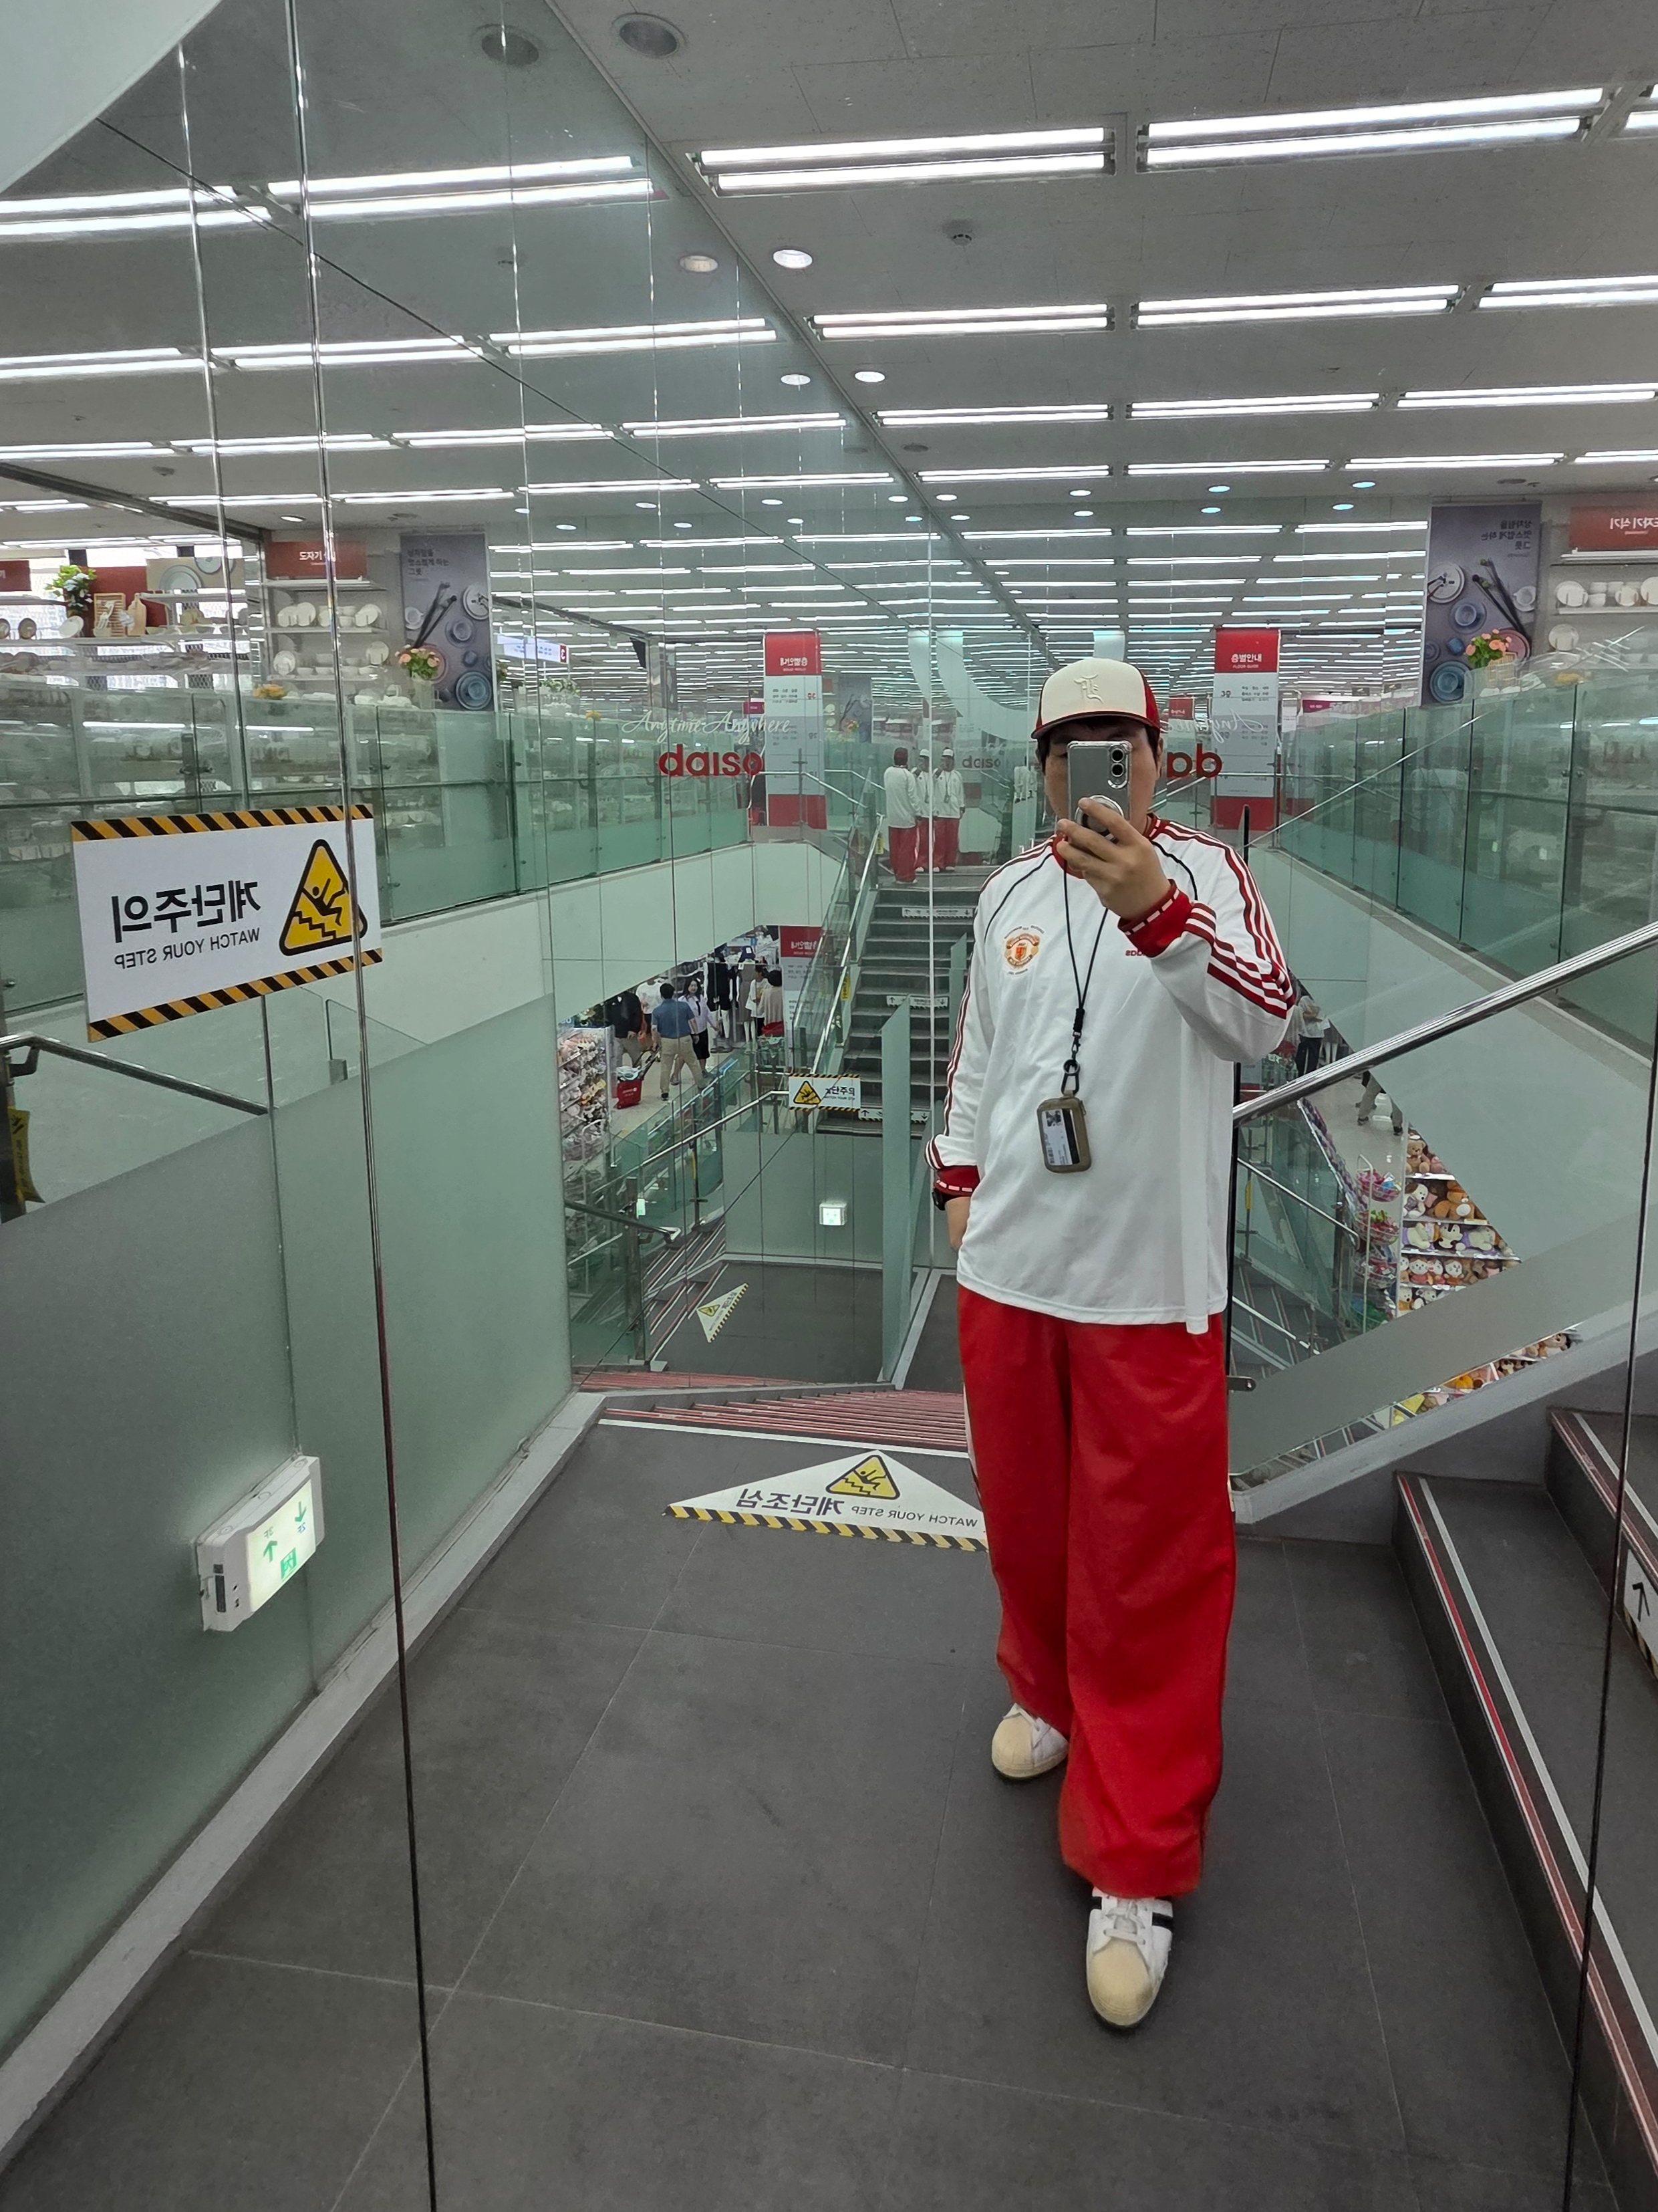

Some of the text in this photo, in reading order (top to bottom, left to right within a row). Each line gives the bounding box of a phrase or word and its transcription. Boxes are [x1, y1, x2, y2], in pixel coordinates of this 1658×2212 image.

[299, 550, 323, 561] 도자기
[1231, 654, 1262, 663] 층별안내
[621, 710, 701, 743] Anytime
[702, 710, 791, 744] Anywhere
[658, 743, 763, 777] daiso
